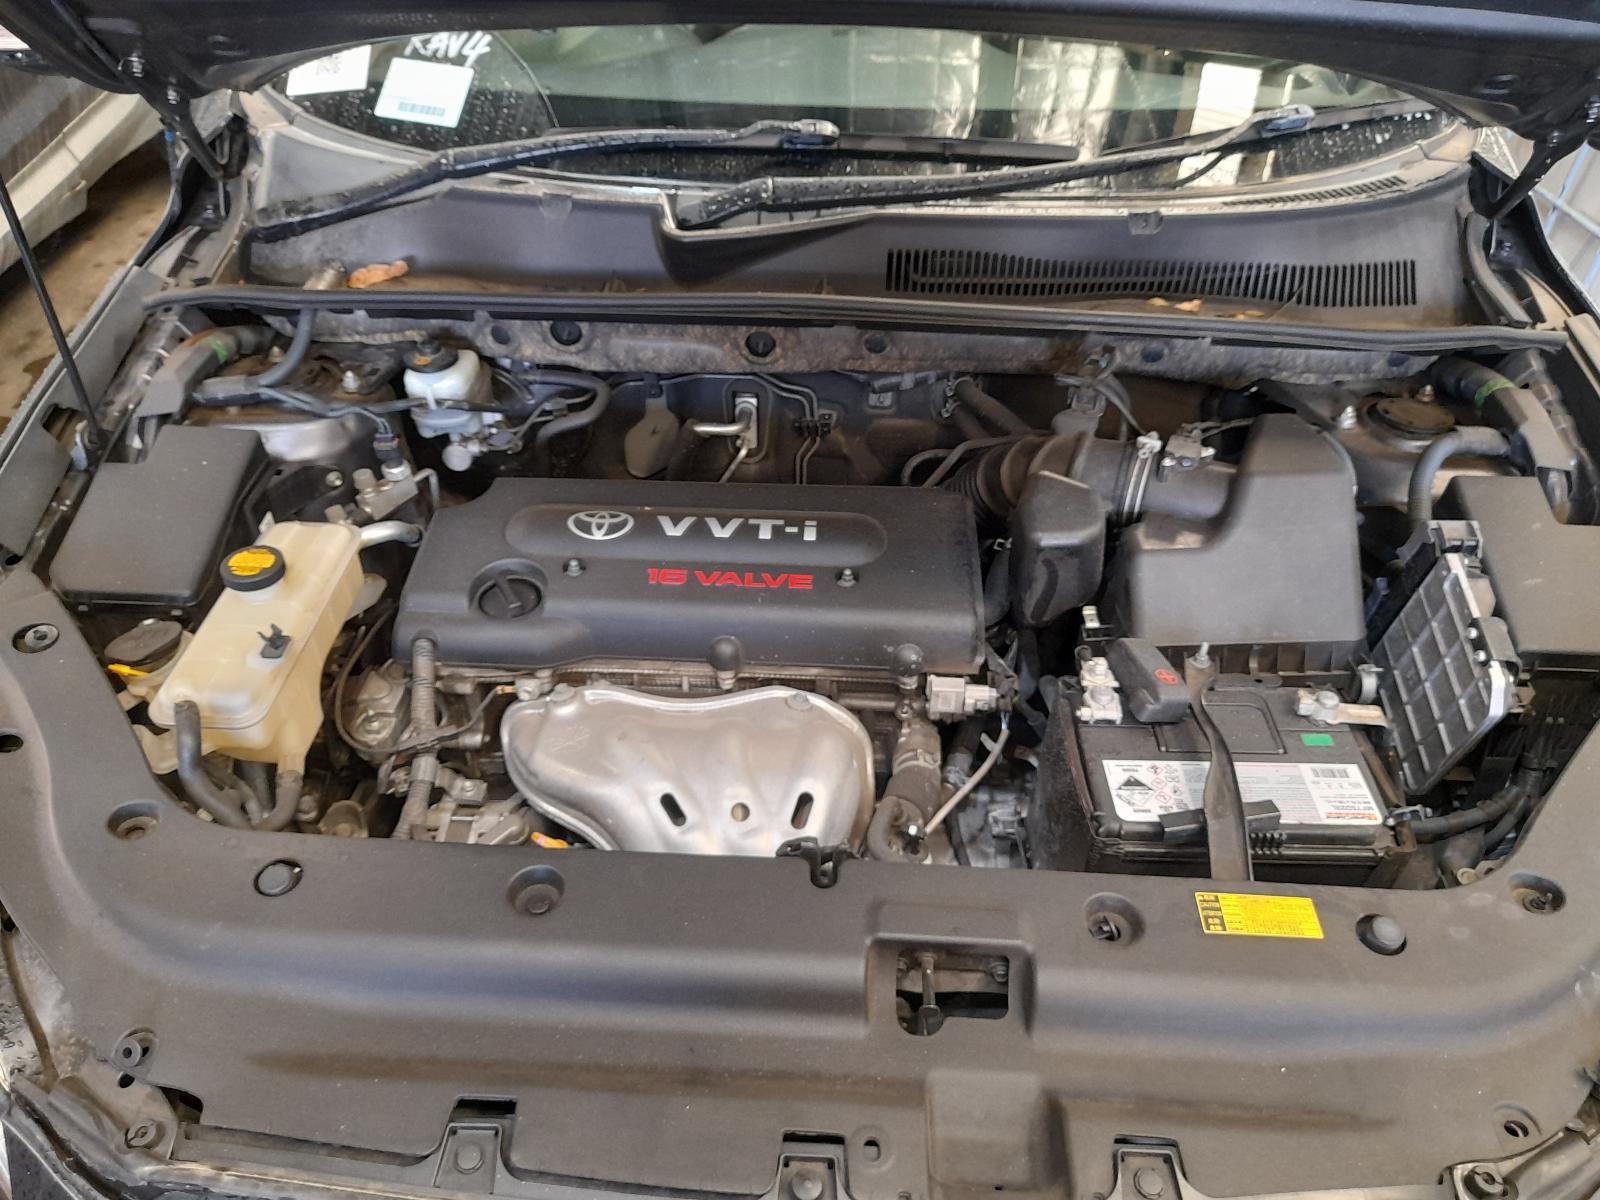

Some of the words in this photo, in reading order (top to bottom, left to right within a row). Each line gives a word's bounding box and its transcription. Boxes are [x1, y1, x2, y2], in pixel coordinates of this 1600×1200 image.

[403, 30, 493, 68] RAV4
[656, 515, 818, 541] VVT-i
[647, 567, 689, 585] 16
[694, 570, 815, 590] VALVE
